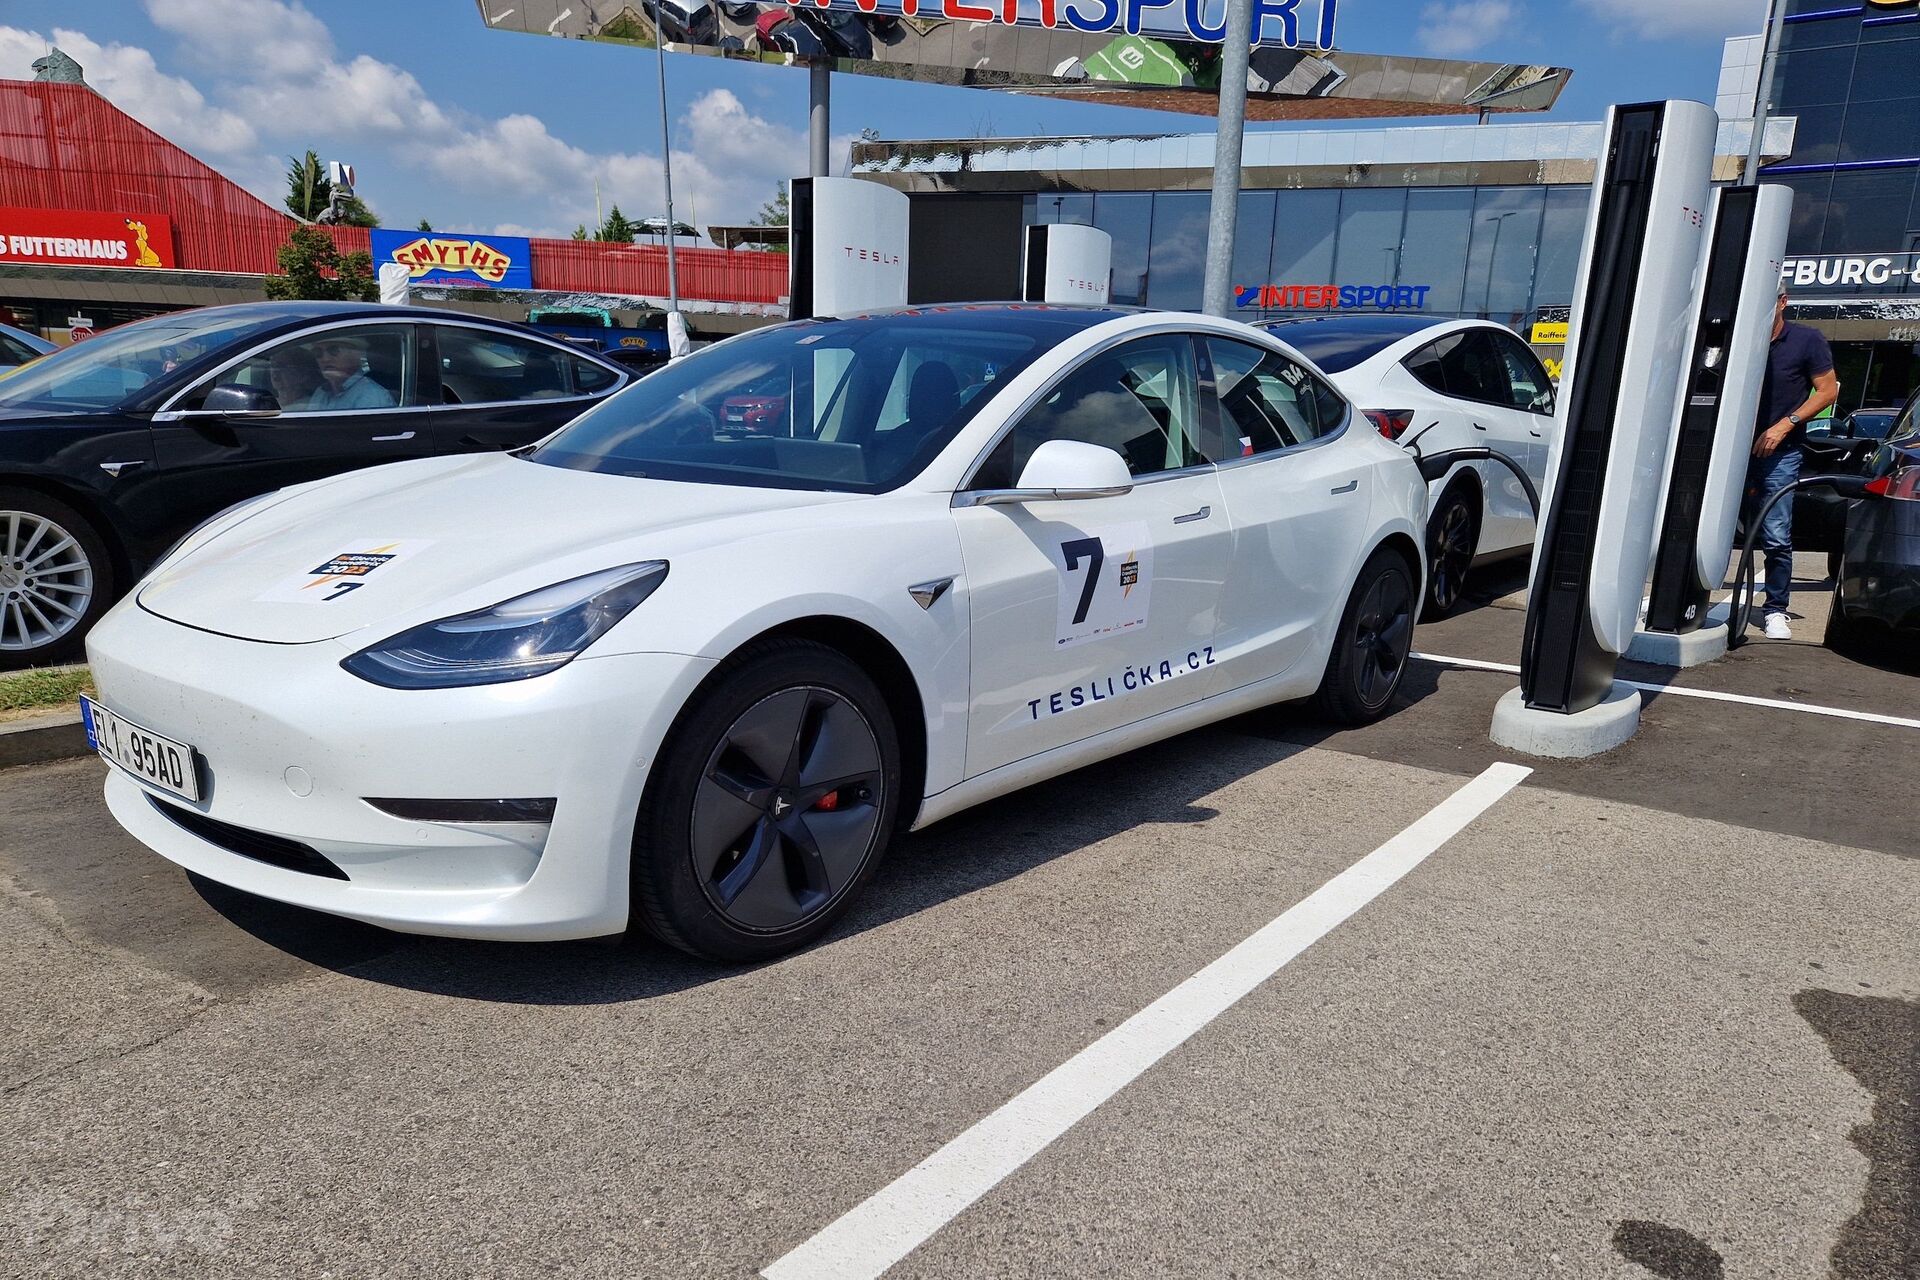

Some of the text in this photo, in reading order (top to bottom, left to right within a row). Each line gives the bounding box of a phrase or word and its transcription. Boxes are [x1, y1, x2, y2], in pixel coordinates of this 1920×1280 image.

[9, 235, 128, 260] FUTTERHAUS
[844, 246, 900, 267] TESLA
[396, 243, 507, 278] SMYTHS
[1068, 279, 1105, 292] TESLA
[1260, 285, 1431, 308] INTERSPORT
[321, 581, 366, 601] 7
[1060, 536, 1104, 625] 7
[1028, 646, 1216, 720] TESLIČKA.CZ
[130, 731, 184, 789] 95AD
